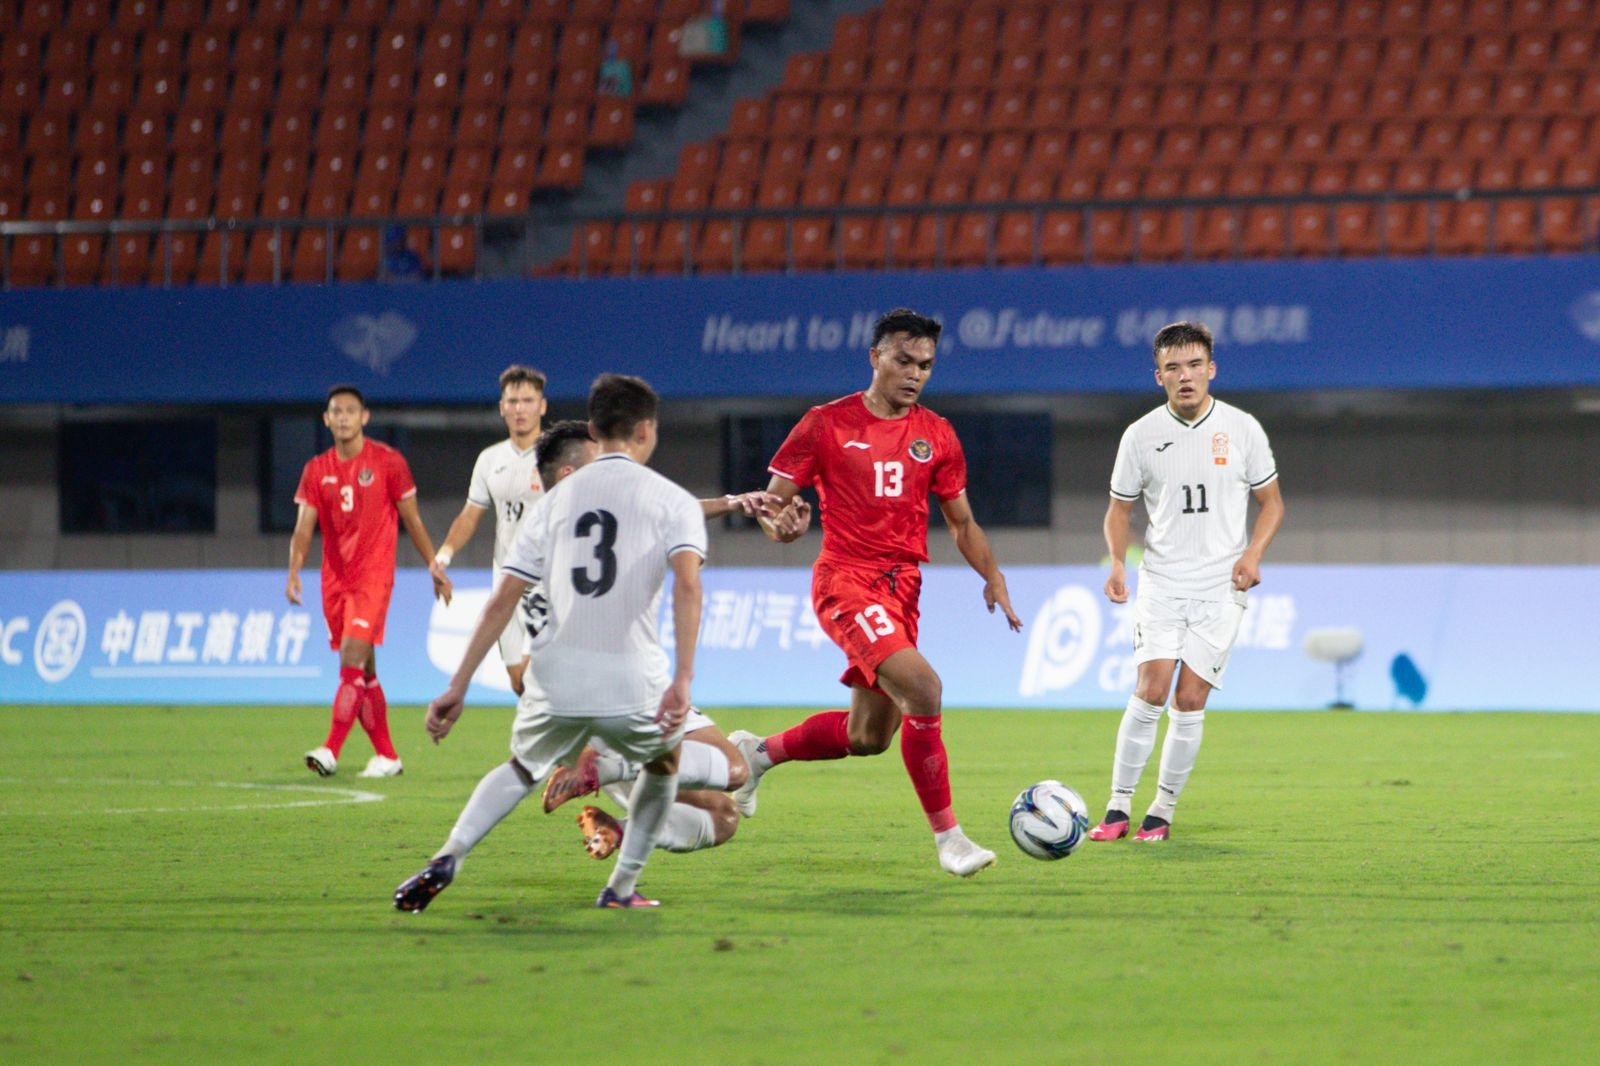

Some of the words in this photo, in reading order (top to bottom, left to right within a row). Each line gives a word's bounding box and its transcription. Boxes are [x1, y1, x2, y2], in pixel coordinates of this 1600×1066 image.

[702, 314, 800, 351] Heart
[806, 315, 844, 351] to
[874, 461, 904, 497] 13
[340, 485, 354, 512] 3
[1182, 484, 1209, 514] 11
[572, 509, 618, 598] 3
[101, 609, 313, 666] 中国工商银行
[855, 604, 895, 643] 13
